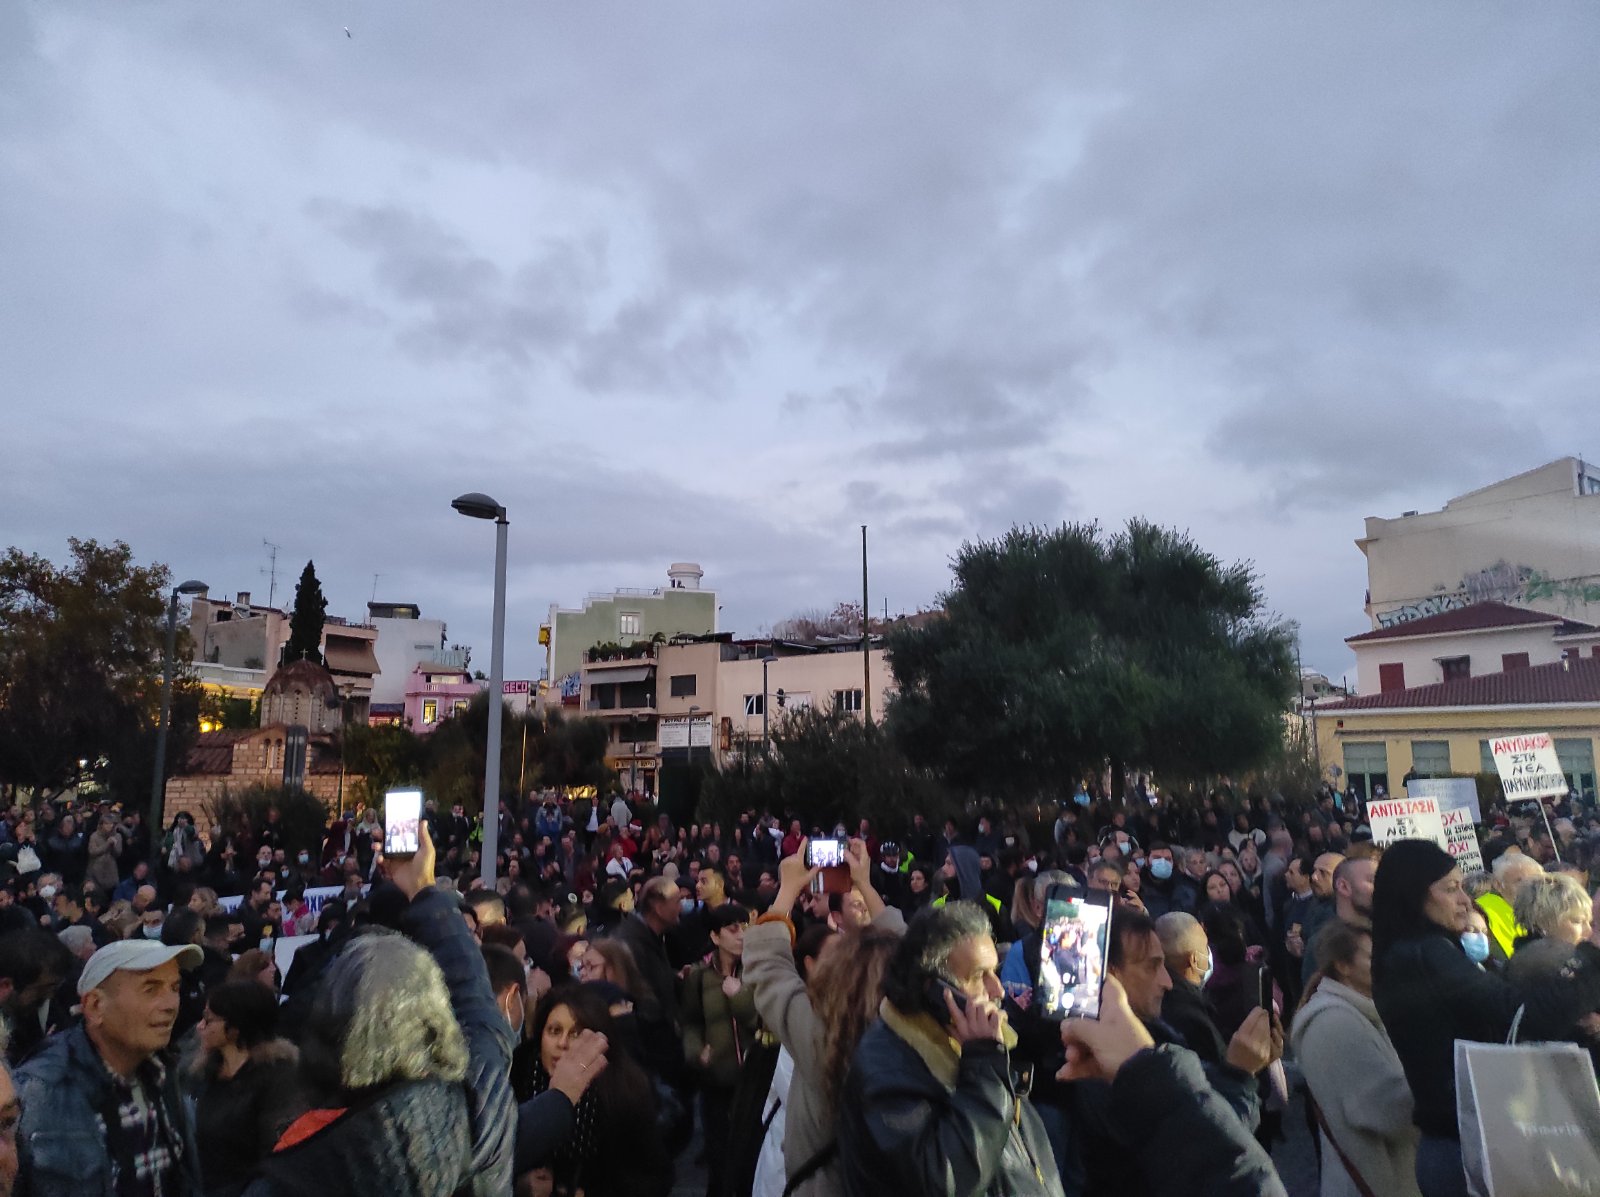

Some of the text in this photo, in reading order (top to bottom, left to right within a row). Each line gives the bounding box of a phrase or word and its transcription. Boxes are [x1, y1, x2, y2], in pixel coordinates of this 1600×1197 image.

[503, 680, 528, 692] GECO
[1494, 735, 1550, 755] ΑΝΥΠΑΚΟΗ
[1510, 752, 1536, 763] ΣΤΗ
[1512, 763, 1546, 776] ΝΕΑ
[1370, 799, 1435, 818] ΑΝΤΙΣΤΑΣΗ
[1441, 810, 1464, 826] ΟΧΙ
[1448, 841, 1469, 855] ΟΧΙ
